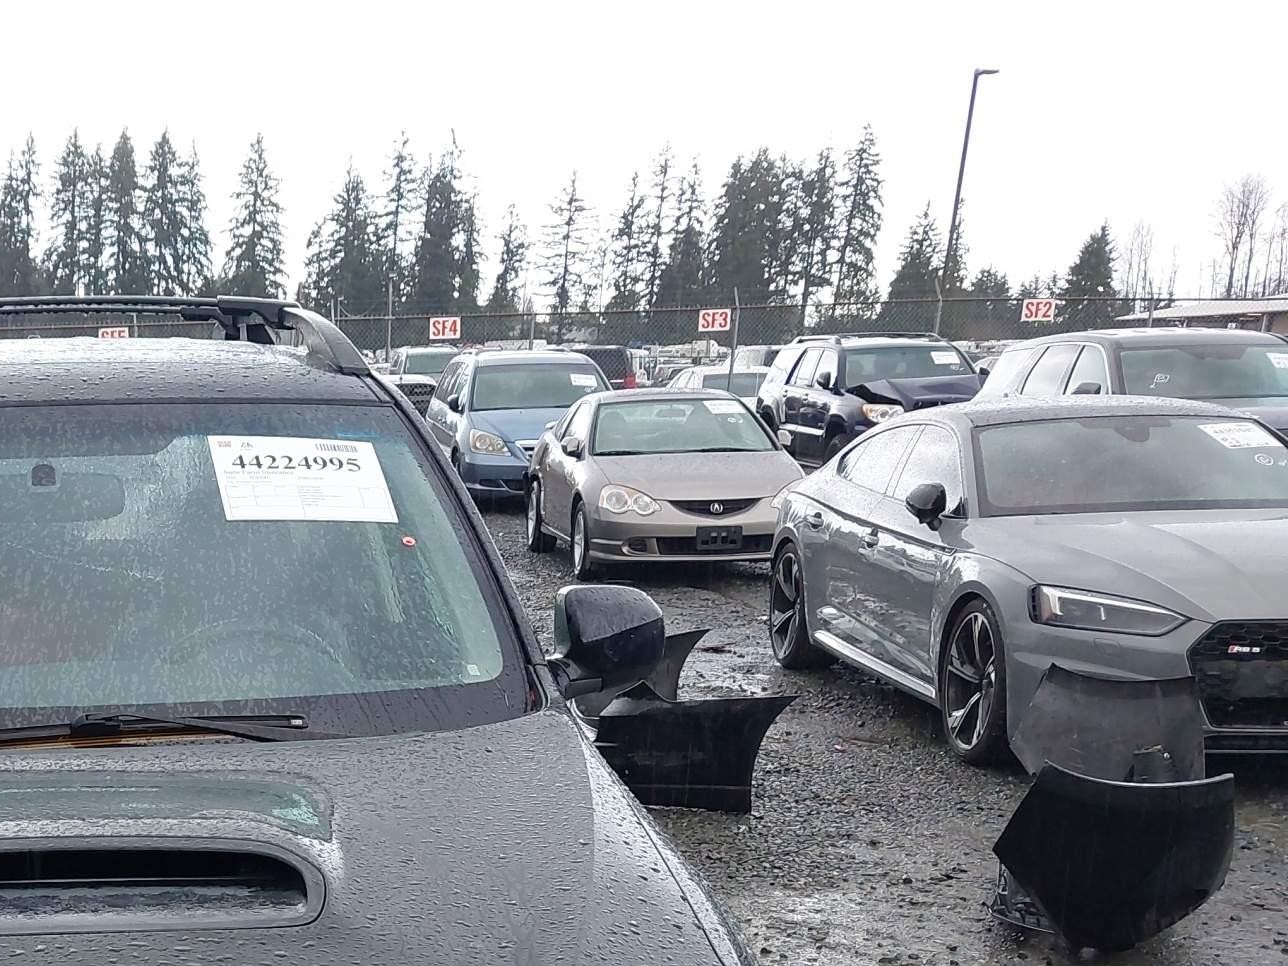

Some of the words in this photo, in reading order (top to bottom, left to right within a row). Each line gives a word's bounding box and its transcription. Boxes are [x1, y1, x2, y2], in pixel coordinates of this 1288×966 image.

[1024, 301, 1052, 319] SF2
[432, 319, 458, 337] SF4
[701, 311, 729, 329] SF3
[231, 453, 361, 472] 44224995
